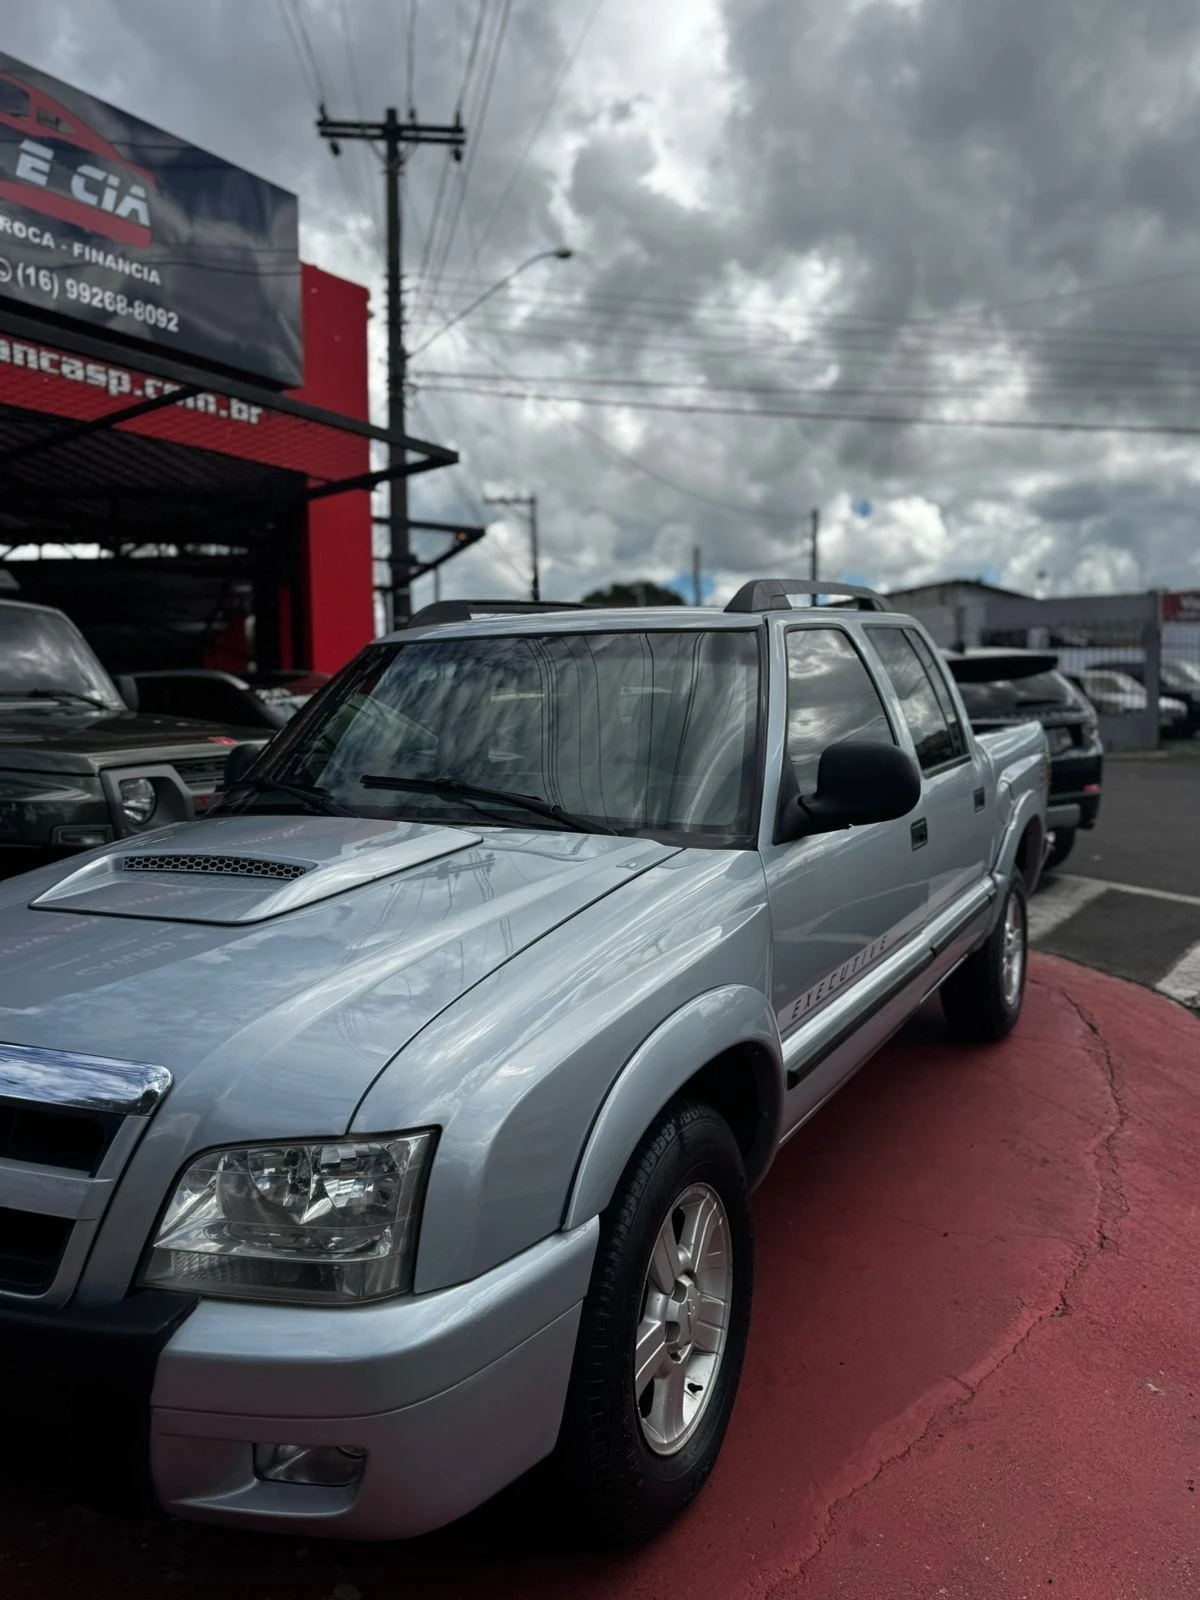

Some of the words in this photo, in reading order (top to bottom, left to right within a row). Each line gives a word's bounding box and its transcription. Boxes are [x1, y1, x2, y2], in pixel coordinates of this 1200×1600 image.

[16, 139, 55, 187] E
[72, 241, 162, 286] FINANCIA
[17, 262, 60, 299] (16)
[65, 277, 180, 333] 99268-8092
[791, 935, 887, 1020] EXECUTIVE
